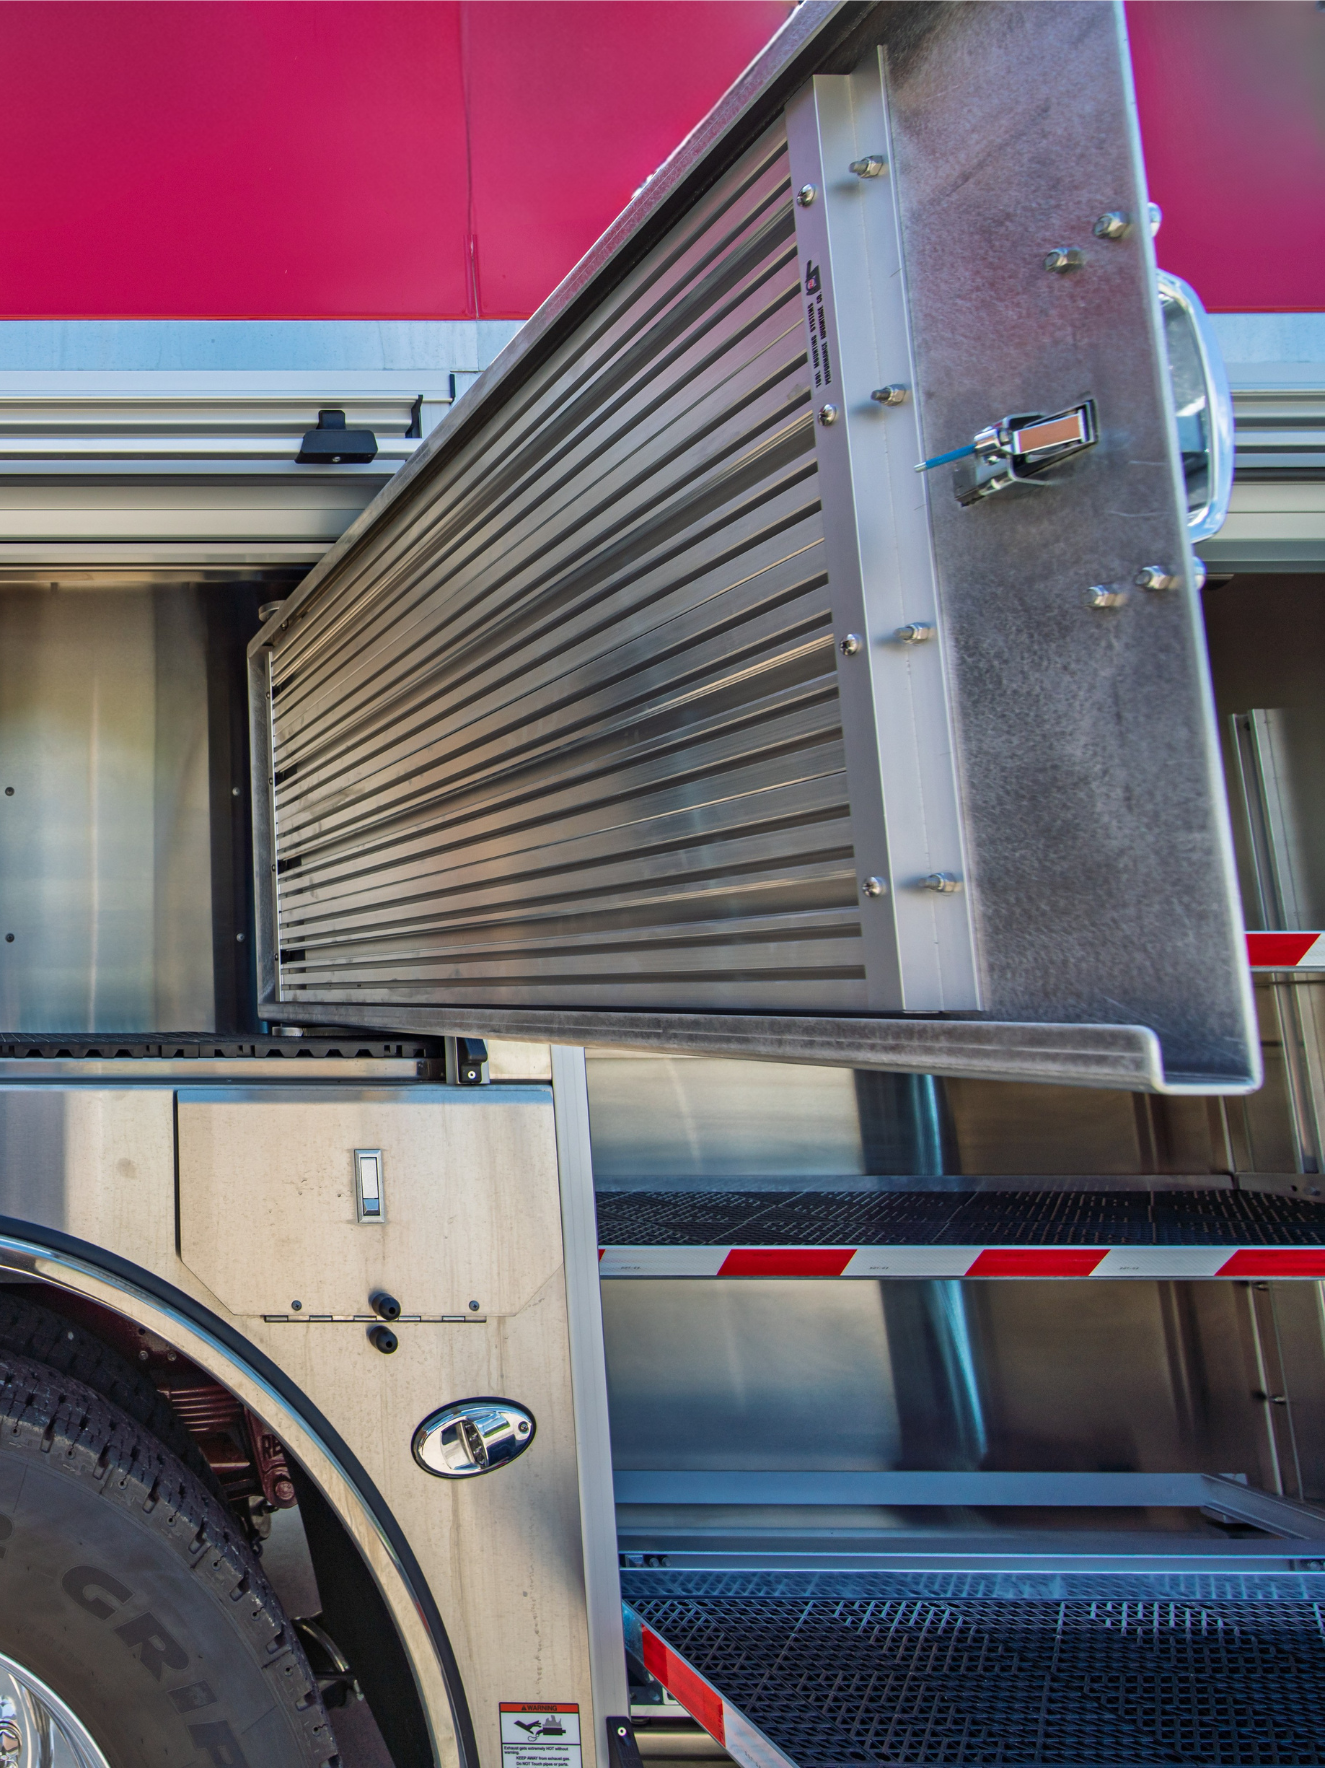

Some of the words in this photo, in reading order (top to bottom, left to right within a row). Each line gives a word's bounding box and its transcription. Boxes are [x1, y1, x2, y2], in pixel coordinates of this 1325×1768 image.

[807, 302, 816, 333] SYSTEMS
[817, 305, 827, 340] ADVANTAGE
[810, 334, 820, 369] MOUNTING
[821, 341, 832, 386] PERFORMANCE
[814, 370, 822, 388] TOOL
